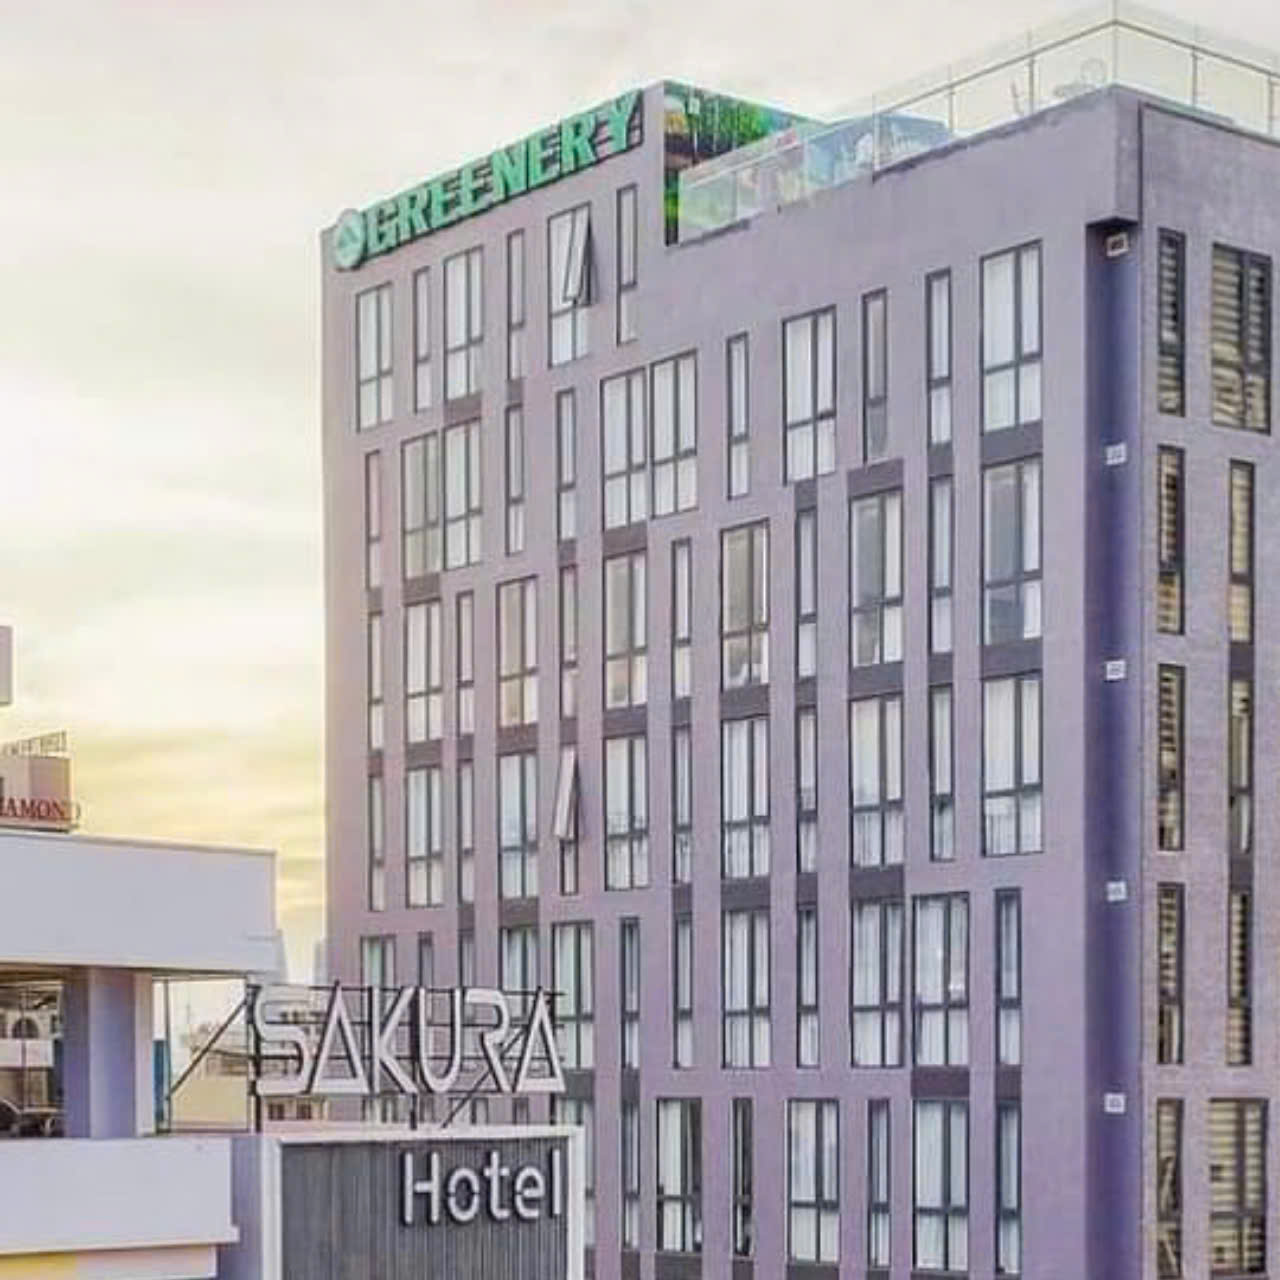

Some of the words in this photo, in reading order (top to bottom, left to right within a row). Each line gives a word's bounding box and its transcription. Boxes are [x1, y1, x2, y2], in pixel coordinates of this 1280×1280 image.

[362, 88, 644, 256] GREENERY
[255, 982, 567, 1095] SAKURA
[403, 1149, 562, 1225] Hotel
